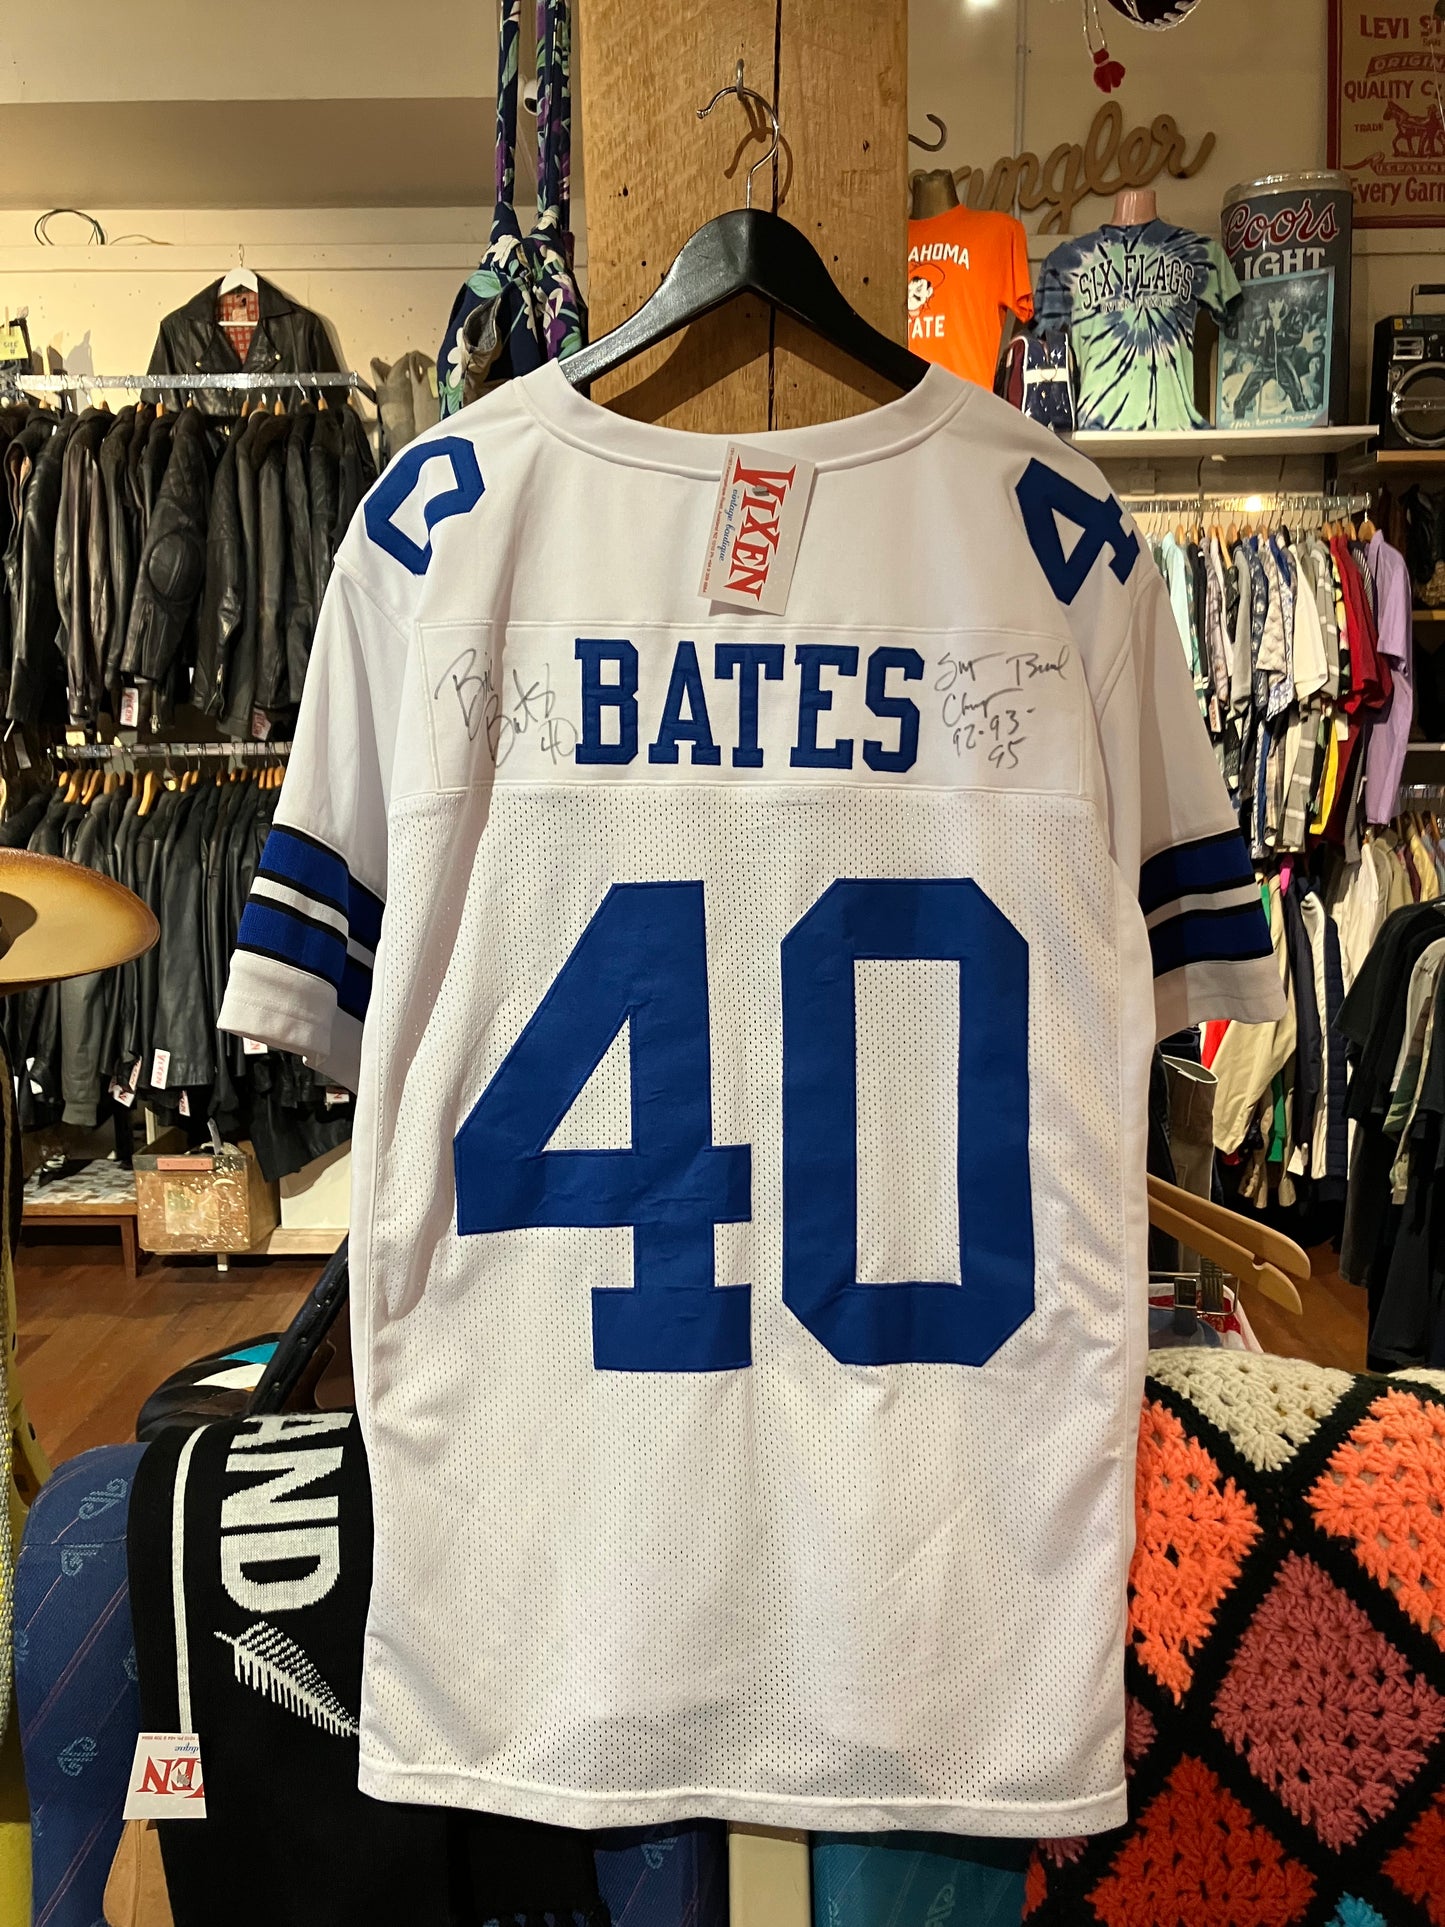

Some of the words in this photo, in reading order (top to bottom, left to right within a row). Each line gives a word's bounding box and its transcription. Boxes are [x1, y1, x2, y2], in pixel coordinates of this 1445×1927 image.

[1360, 14, 1409, 39] LEVI
[1344, 80, 1414, 103] QUALITY
[1354, 123, 1384, 132] TRADE
[1221, 198, 1340, 258] Coors
[1079, 258, 1114, 312] SIX
[1123, 253, 1195, 304] FLAGS
[1232, 248, 1326, 280] IGHT
[724, 489, 738, 522] vintage
[718, 523, 734, 562] boutique
[723, 455, 797, 602] VIXEN
[1015, 457, 1141, 606] 4
[575, 638, 925, 773] BATES
[988, 736, 1028, 769] 95
[453, 877, 1036, 1372] 40
